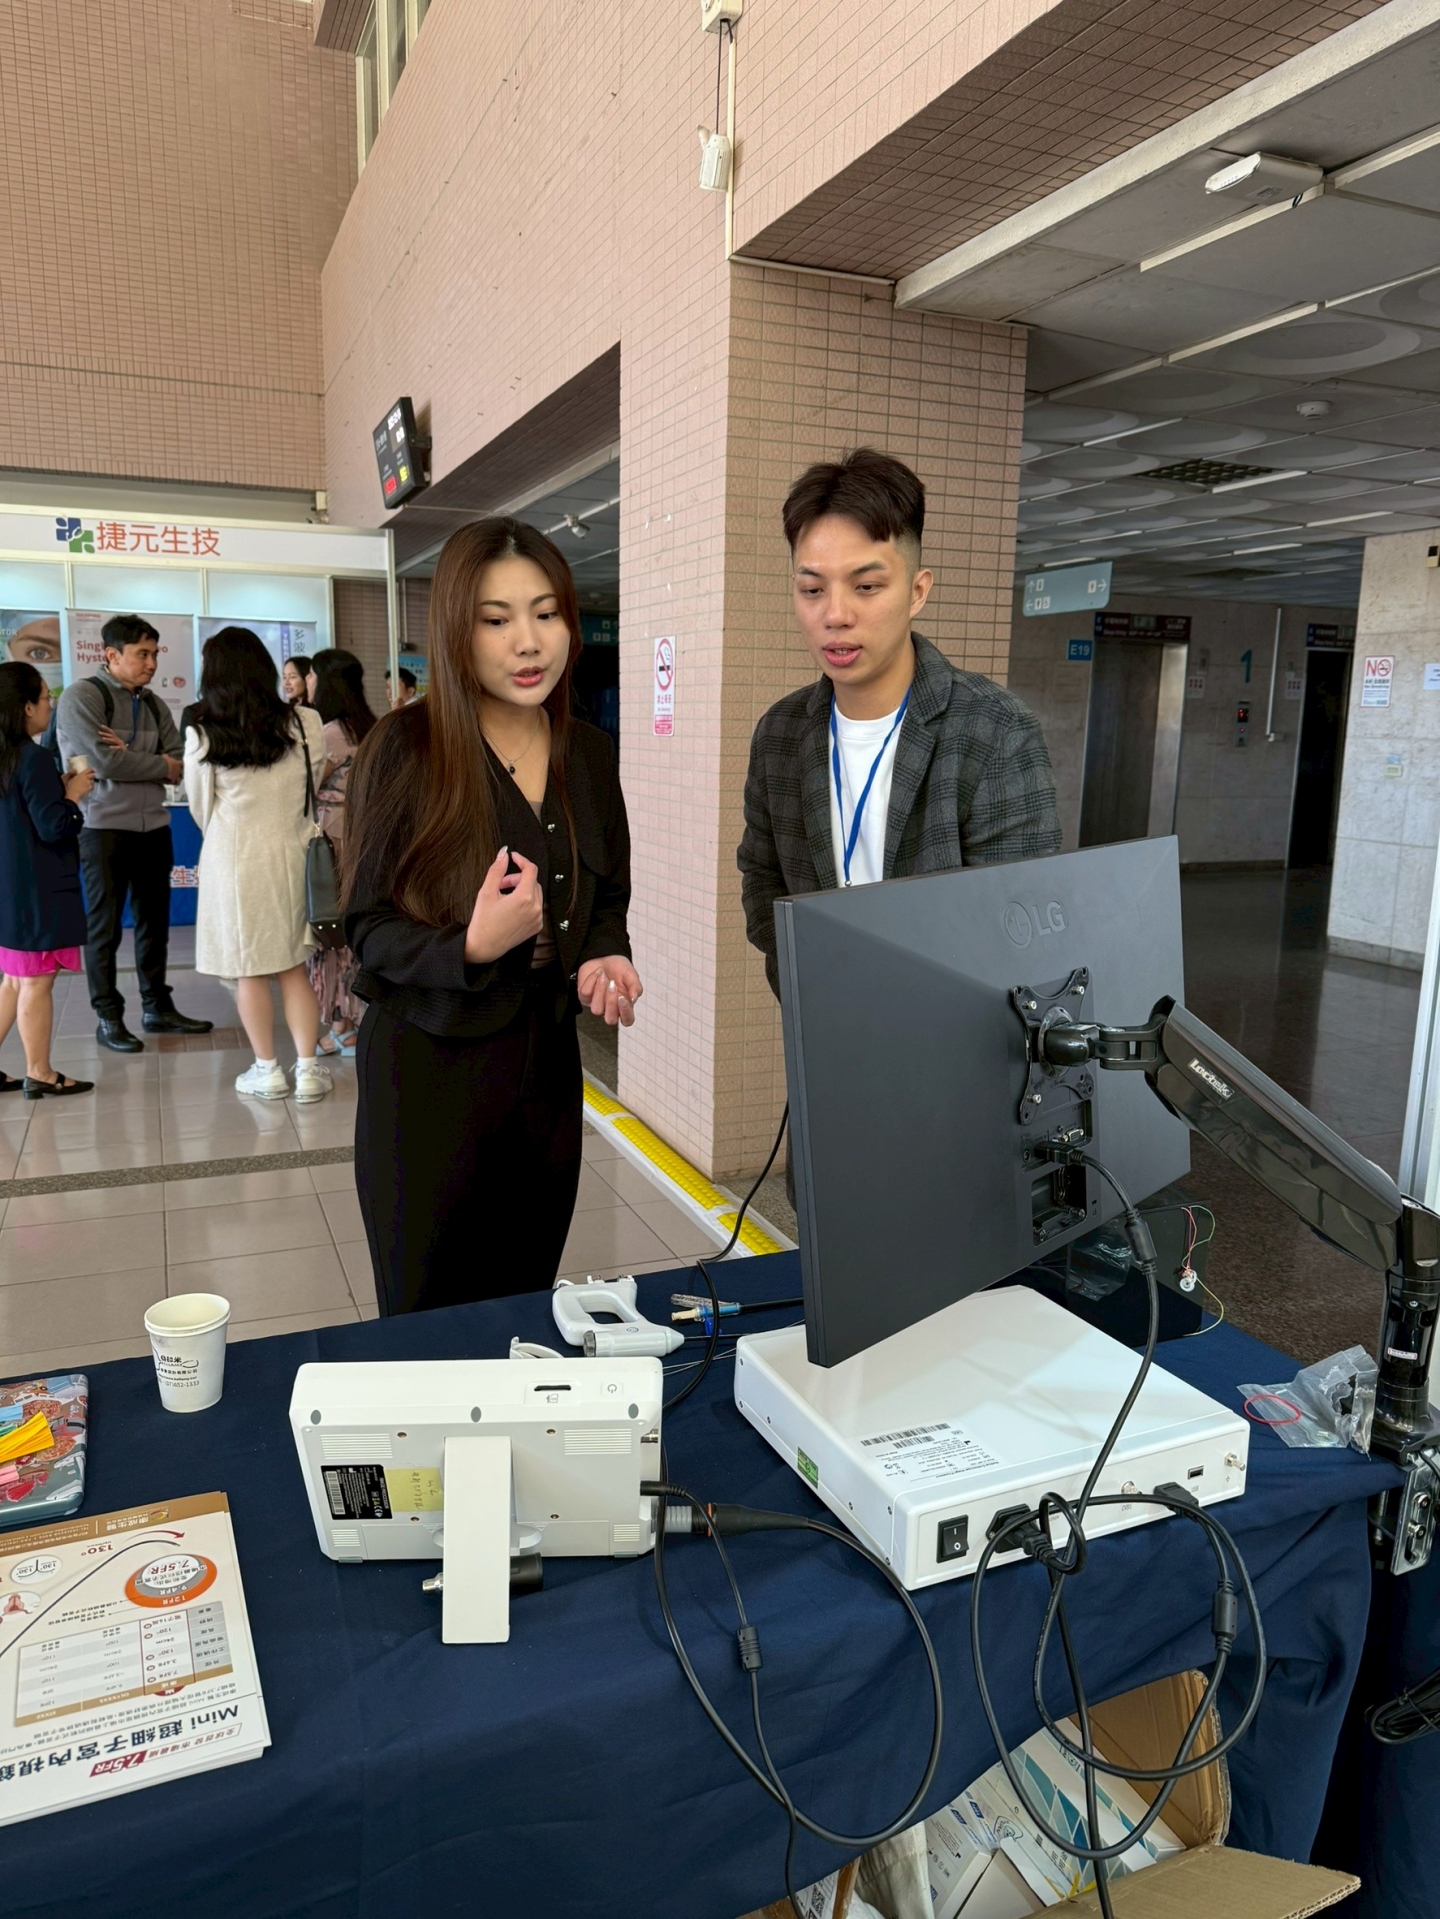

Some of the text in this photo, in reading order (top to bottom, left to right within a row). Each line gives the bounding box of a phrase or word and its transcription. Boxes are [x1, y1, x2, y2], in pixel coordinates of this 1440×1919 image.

[97, 521, 220, 556] 捷元生技
[1070, 644, 1090, 656] E19
[77, 652, 107, 664] Hyste
[1241, 650, 1252, 683] 1
[1034, 901, 1066, 936] LG
[80, 1544, 113, 1556] 130°
[150, 1559, 190, 1574] 7.5FR
[159, 1585, 187, 1595] 9.4FR
[162, 1595, 186, 1605] 12FR
[191, 1705, 238, 1729] Mini
[95, 1753, 140, 1774] 7.5FR
